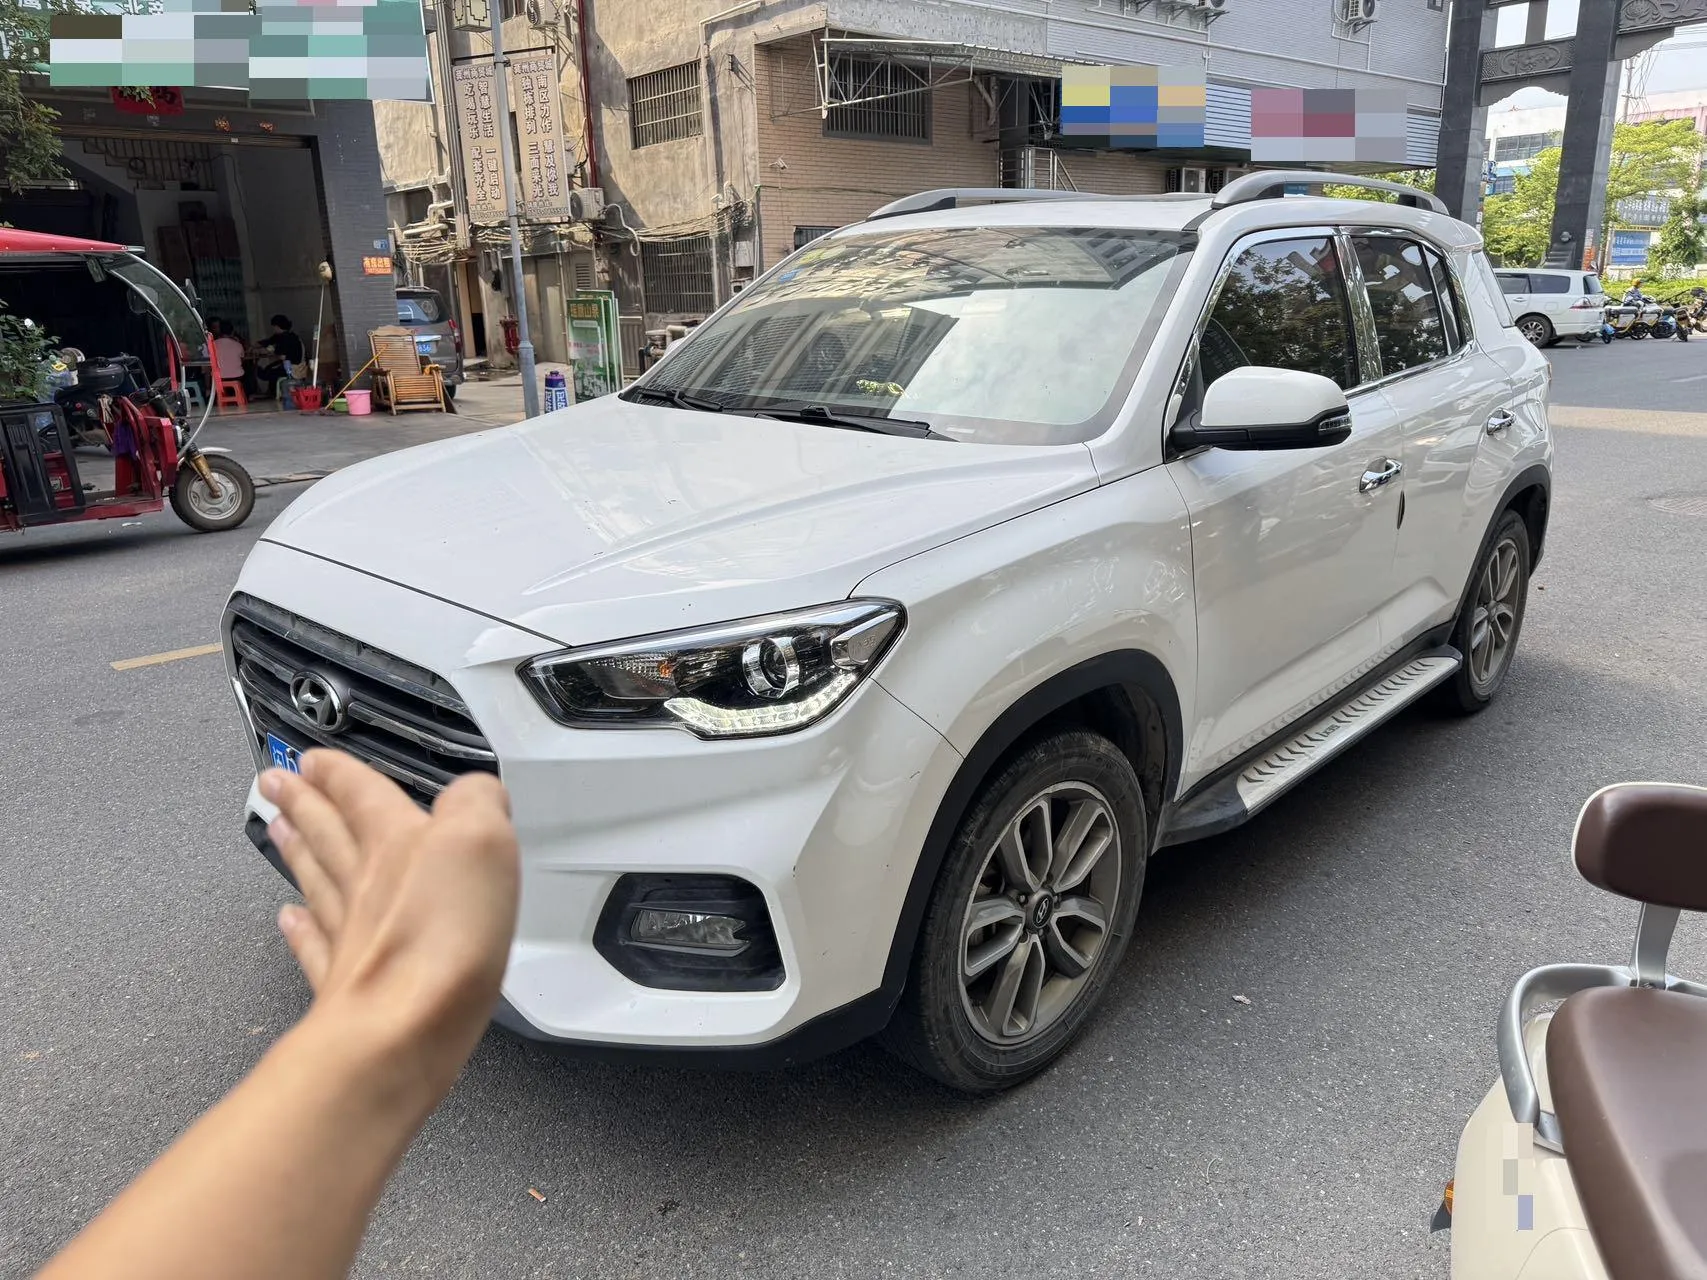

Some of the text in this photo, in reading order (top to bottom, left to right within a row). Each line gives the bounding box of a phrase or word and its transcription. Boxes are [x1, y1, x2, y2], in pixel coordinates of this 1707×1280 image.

[465, 82, 487, 200] 吃喝玩乐 配套齐全
[479, 81, 500, 200] 智慧生活 一键启动
[537, 75, 552, 133] 南区力作
[528, 142, 544, 198] 三面采光
